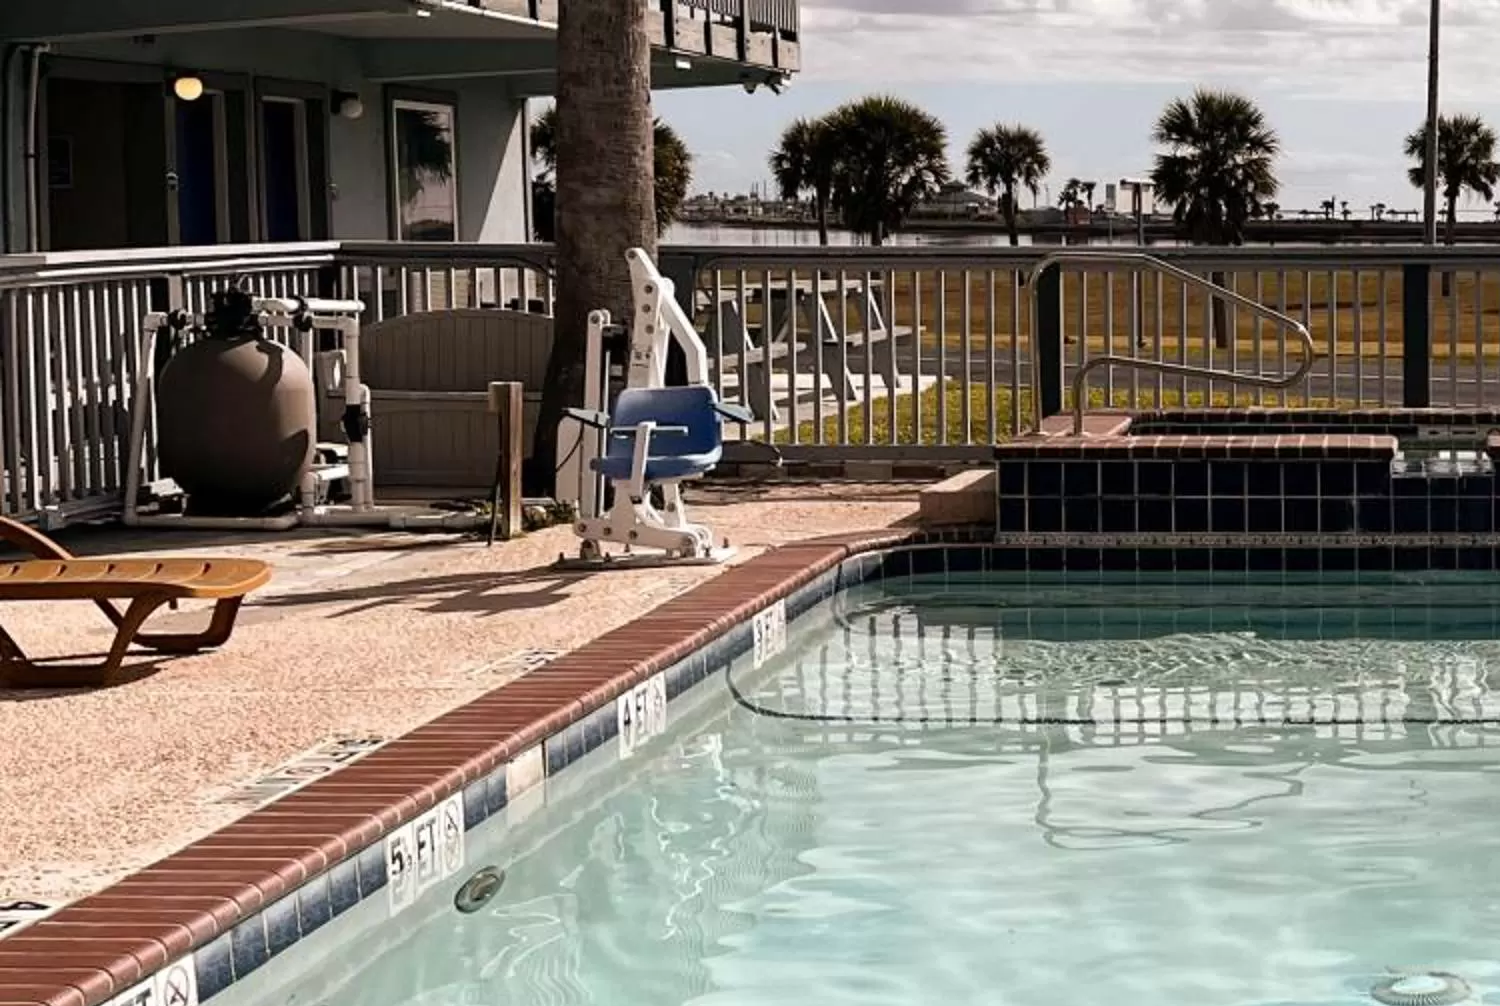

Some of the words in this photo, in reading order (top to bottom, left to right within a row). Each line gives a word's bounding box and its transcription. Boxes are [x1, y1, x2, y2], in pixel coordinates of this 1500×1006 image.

[623, 696, 632, 727] 4
[635, 687, 649, 720] FT
[416, 816, 437, 861] FT
